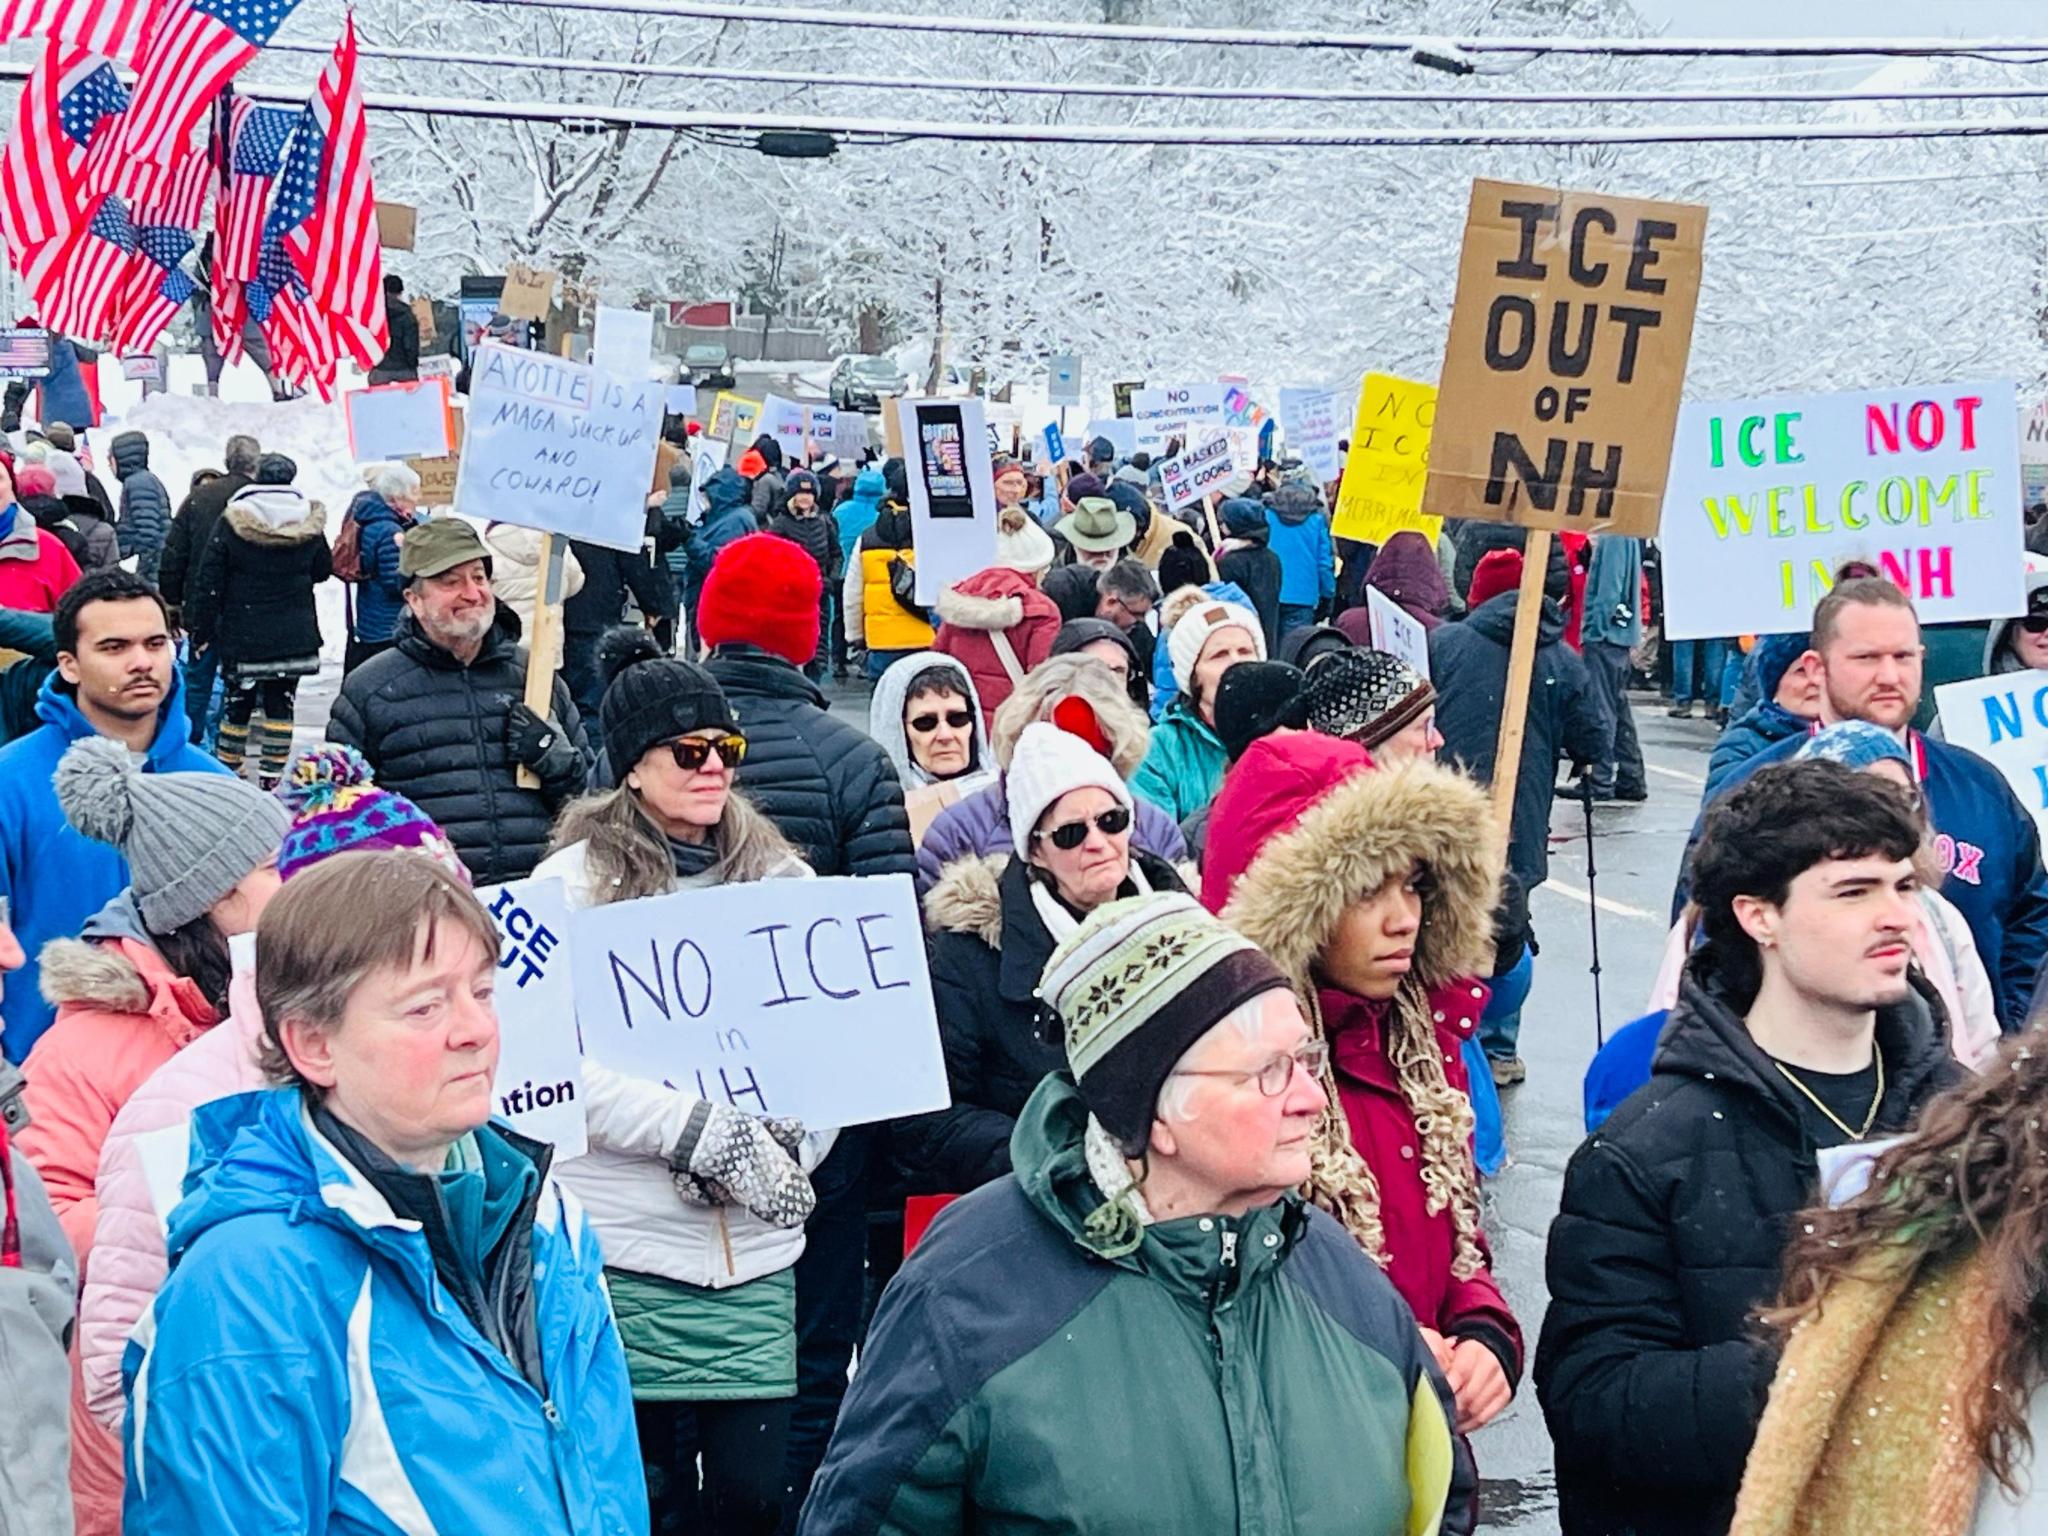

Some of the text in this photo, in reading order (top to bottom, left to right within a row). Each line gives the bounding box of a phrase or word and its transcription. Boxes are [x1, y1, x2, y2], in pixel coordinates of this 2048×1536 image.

[1496, 200, 1677, 295] ICE
[1485, 295, 1661, 383] OUT
[481, 353, 584, 403] AYOTTE
[602, 381, 624, 409] IS
[632, 393, 645, 417] A
[1167, 390, 1190, 403] NO
[1535, 386, 1591, 423] OF
[492, 401, 555, 433] MAGA
[1155, 421, 1187, 432] CAMP
[1378, 392, 1438, 428] NO
[1710, 396, 1982, 468] ICE NOT
[2026, 419, 2048, 442] N
[535, 448, 577, 467] AND
[1163, 462, 1180, 478] NO
[1183, 438, 1228, 472] MASKED
[1484, 432, 1622, 518] NH
[490, 468, 602, 504] COWARD!
[1171, 479, 1192, 498] ICE
[1701, 469, 1994, 540] WELCOME
[1880, 546, 1953, 598] NH
[1932, 834, 1985, 885] OX
[488, 887, 560, 963] ICE
[498, 932, 545, 988] UT
[608, 913, 911, 1029] NO ICE
[716, 1027, 750, 1052] in
